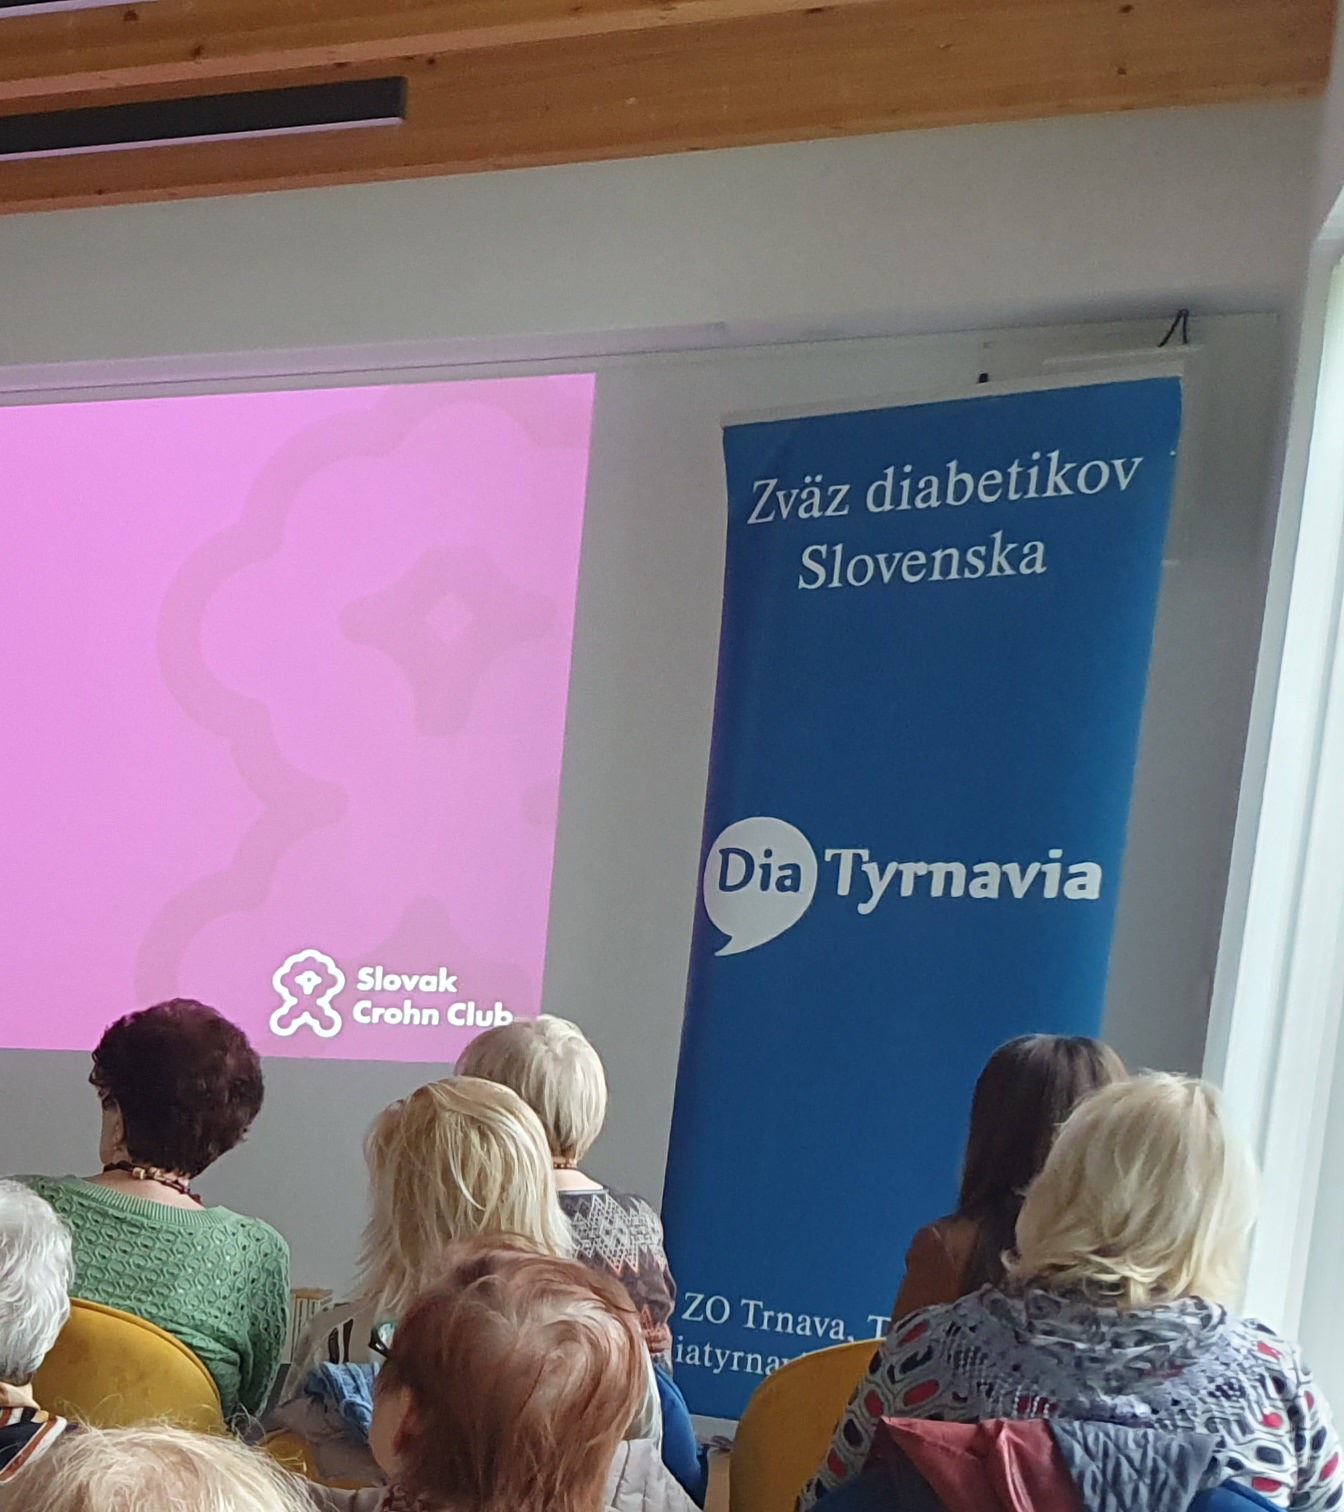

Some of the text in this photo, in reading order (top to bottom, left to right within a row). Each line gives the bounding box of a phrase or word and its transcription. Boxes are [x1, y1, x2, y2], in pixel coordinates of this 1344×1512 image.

[747, 449, 1144, 525] Zväz diabetikov
[797, 529, 1048, 590] Slovenska
[717, 847, 1103, 916] Dia Tyrnavia
[356, 964, 458, 993] Slovak
[352, 998, 514, 1027] Crohn Club
[681, 1291, 731, 1325] ZO
[740, 1298, 856, 1343] Trnava,
